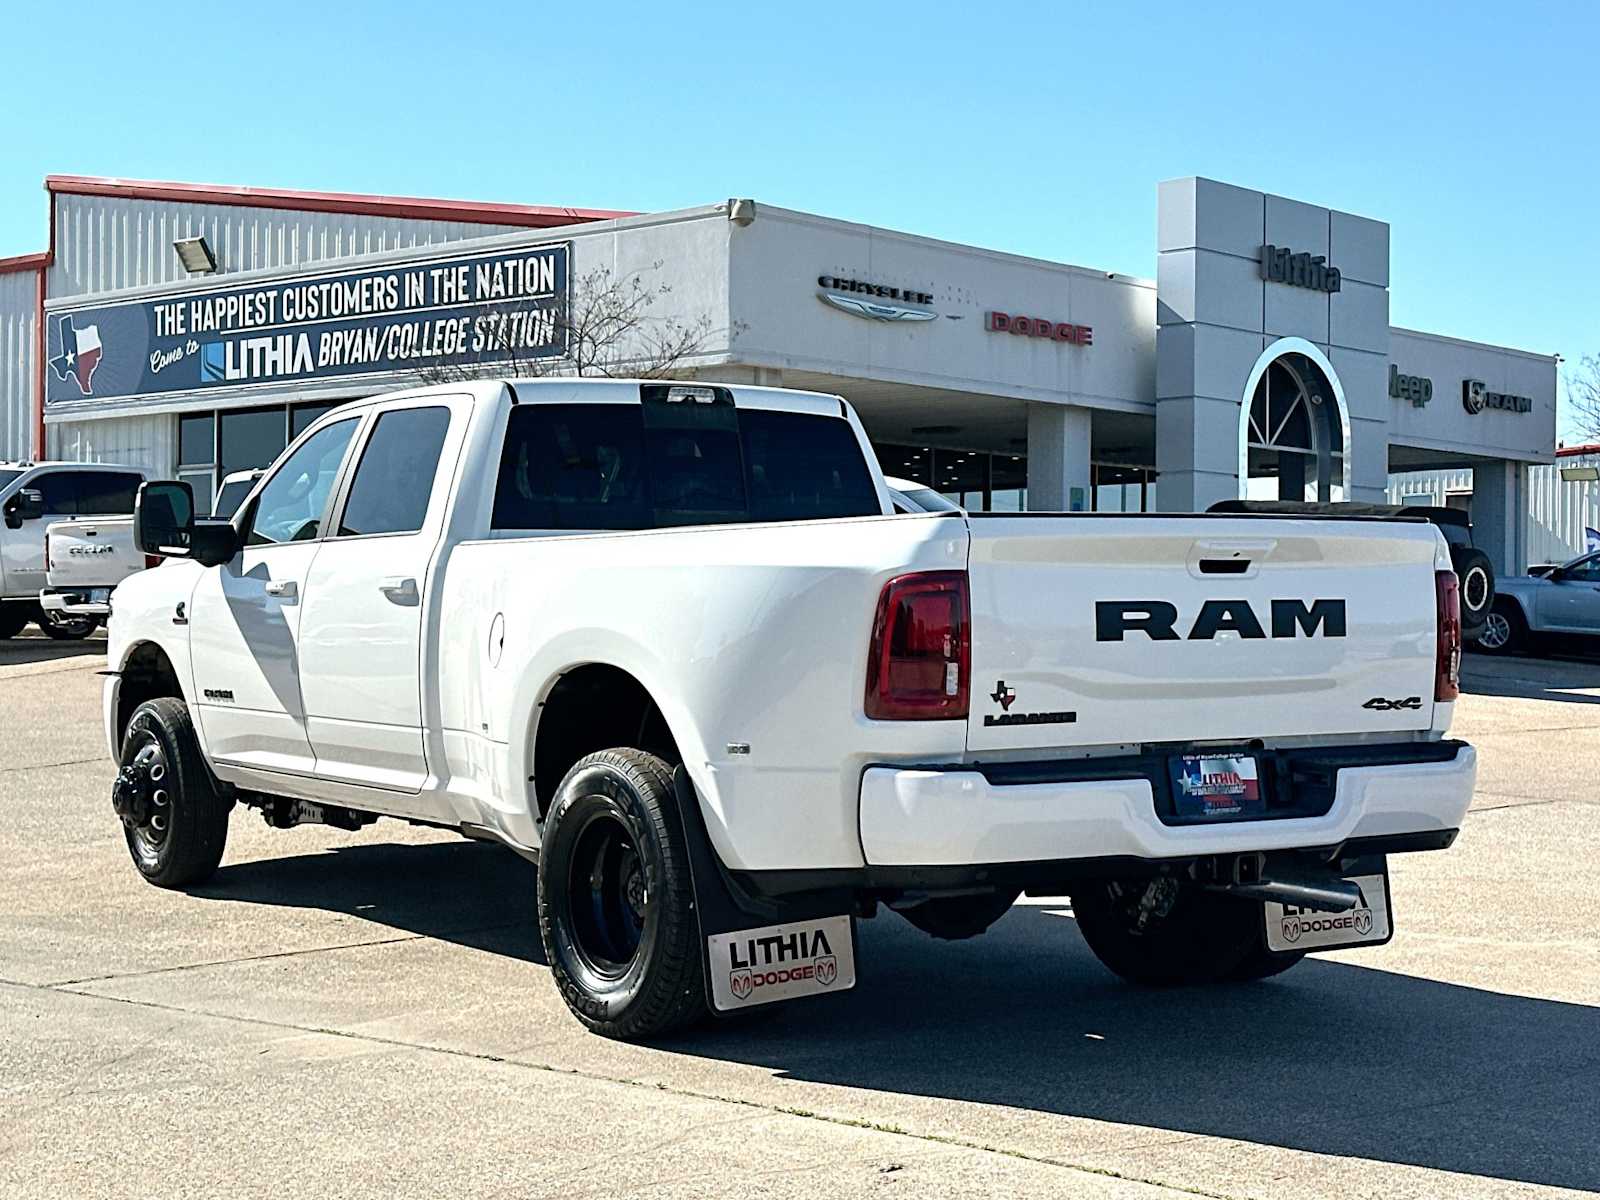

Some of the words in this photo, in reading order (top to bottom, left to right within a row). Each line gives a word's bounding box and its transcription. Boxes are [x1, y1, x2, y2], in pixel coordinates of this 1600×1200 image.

[153, 301, 187, 337] THE
[190, 290, 279, 333] HAPPIEST
[282, 274, 399, 322] CUSTOMERS
[404, 271, 425, 308] IN
[430, 264, 470, 304] THE
[475, 254, 556, 300] NATION
[149, 345, 184, 373] Come
[185, 338, 200, 355] to
[224, 332, 315, 380] LITHIA
[317, 315, 471, 368] BRYAN/COLLEGE
[472, 307, 556, 353] STATION
[985, 311, 1093, 346] DODGE
[1388, 363, 1433, 408] Jeep
[1486, 391, 1532, 413] RAM
[1095, 598, 1347, 642] RAM
[1202, 771, 1241, 785] LITHIA
[1301, 917, 1354, 933] DODGE
[729, 929, 833, 969] LITHIA
[752, 965, 815, 988] DODGE
